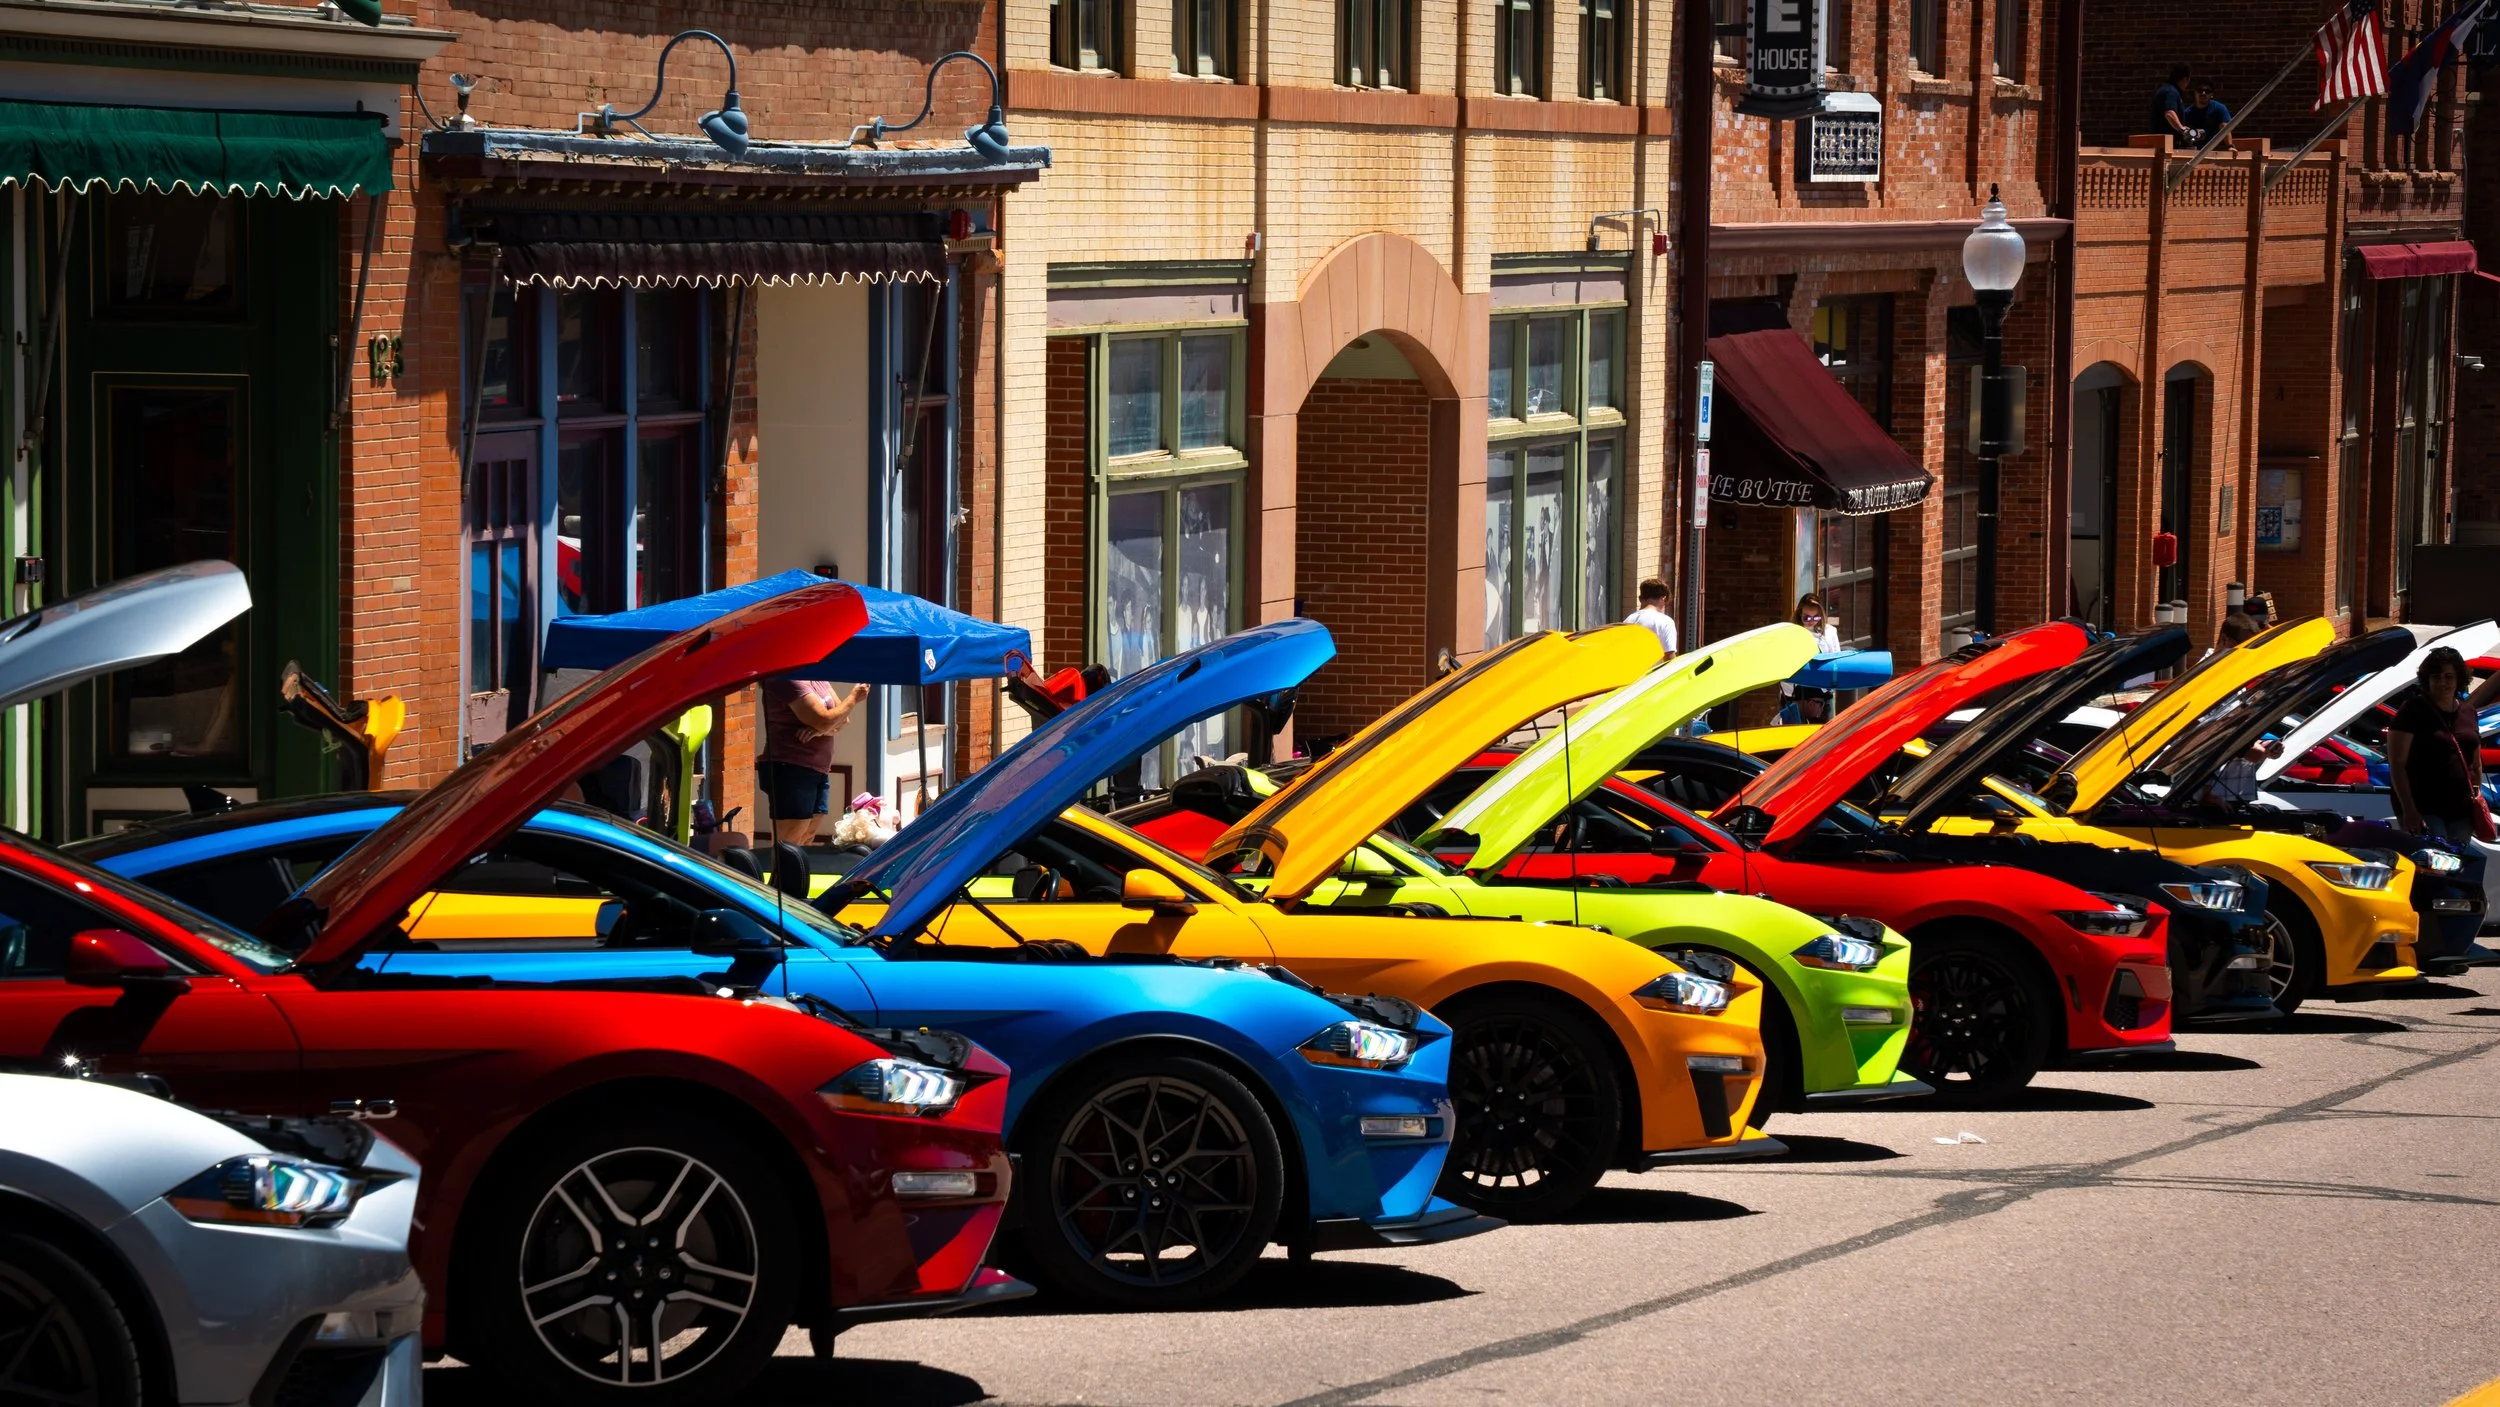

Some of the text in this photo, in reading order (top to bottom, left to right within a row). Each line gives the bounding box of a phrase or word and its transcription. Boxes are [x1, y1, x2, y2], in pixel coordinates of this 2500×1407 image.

[1757, 48, 1809, 70] HOUSE
[1709, 474, 1813, 503] HE BUTTE
[1848, 488, 1863, 509] THE
[1865, 485, 1889, 507] BUTTE
